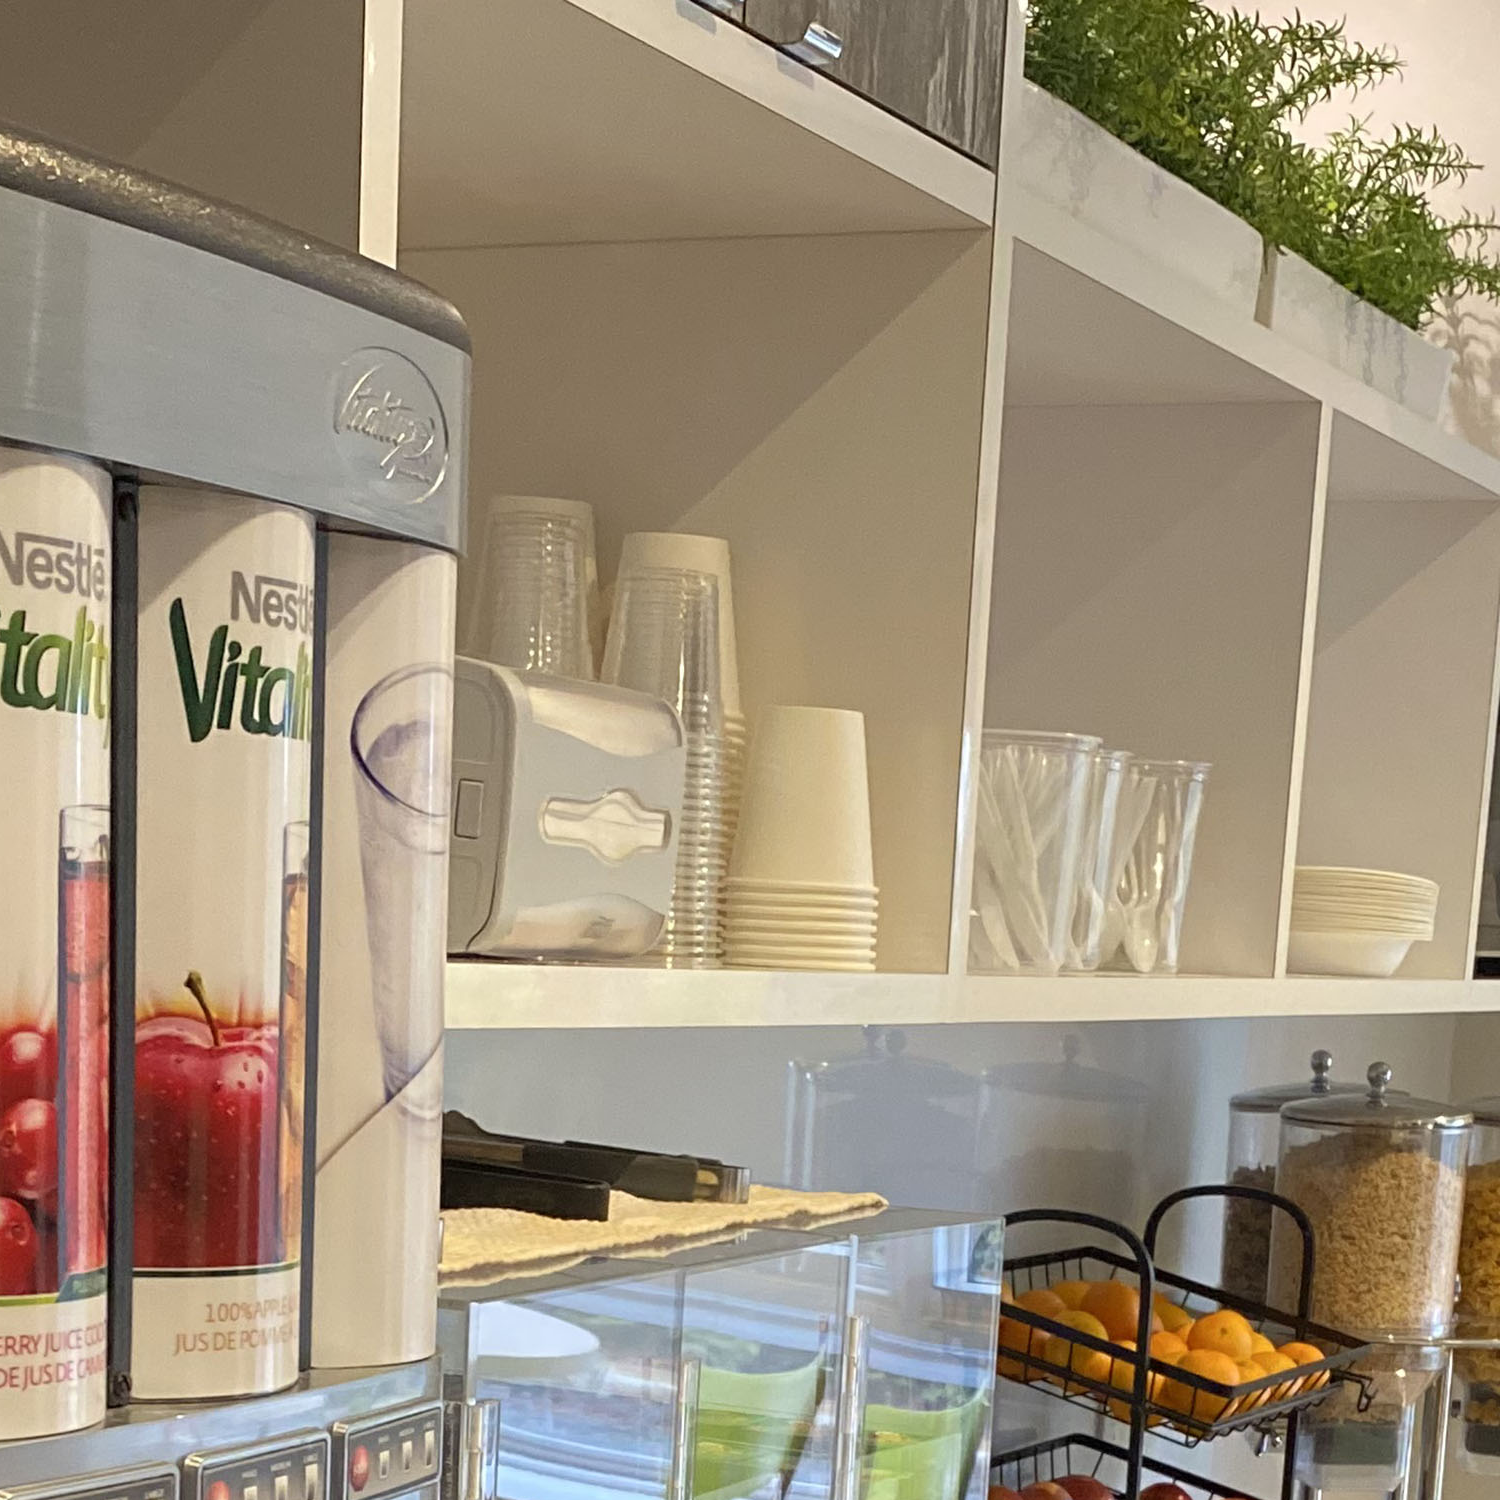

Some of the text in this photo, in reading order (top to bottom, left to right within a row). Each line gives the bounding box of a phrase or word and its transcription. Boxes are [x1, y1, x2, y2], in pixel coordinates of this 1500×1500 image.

[169, 596, 312, 743] Vitali
[43, 1328, 83, 1359] JUICE
[173, 1332, 210, 1356] JUS
[213, 1330, 237, 1351] DE
[21, 1364, 53, 1391] JUS
[55, 1361, 75, 1383] DE
